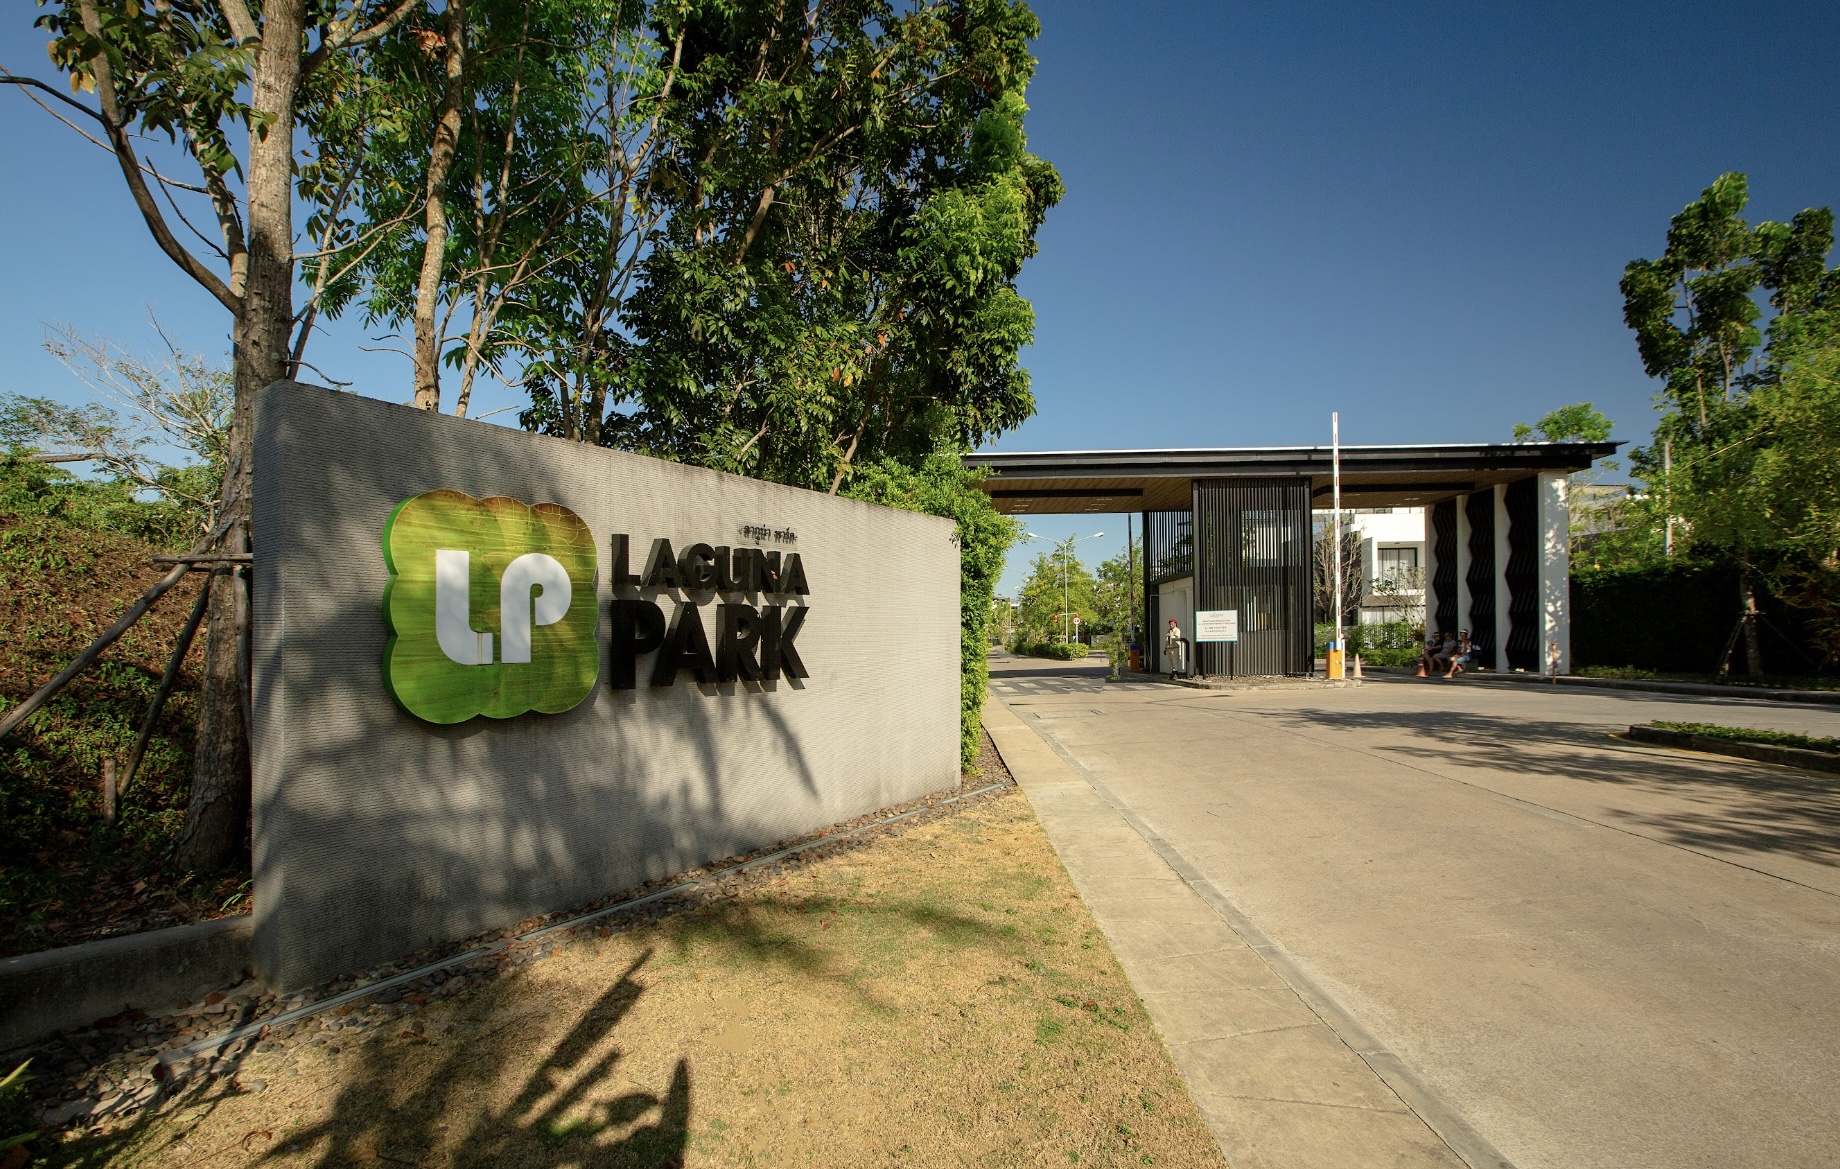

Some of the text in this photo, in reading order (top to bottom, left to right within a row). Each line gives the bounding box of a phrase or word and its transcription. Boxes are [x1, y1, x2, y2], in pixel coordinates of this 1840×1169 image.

[435, 548, 573, 666] LP
[611, 533, 810, 597] LAGUNA
[611, 600, 810, 690] PARK
